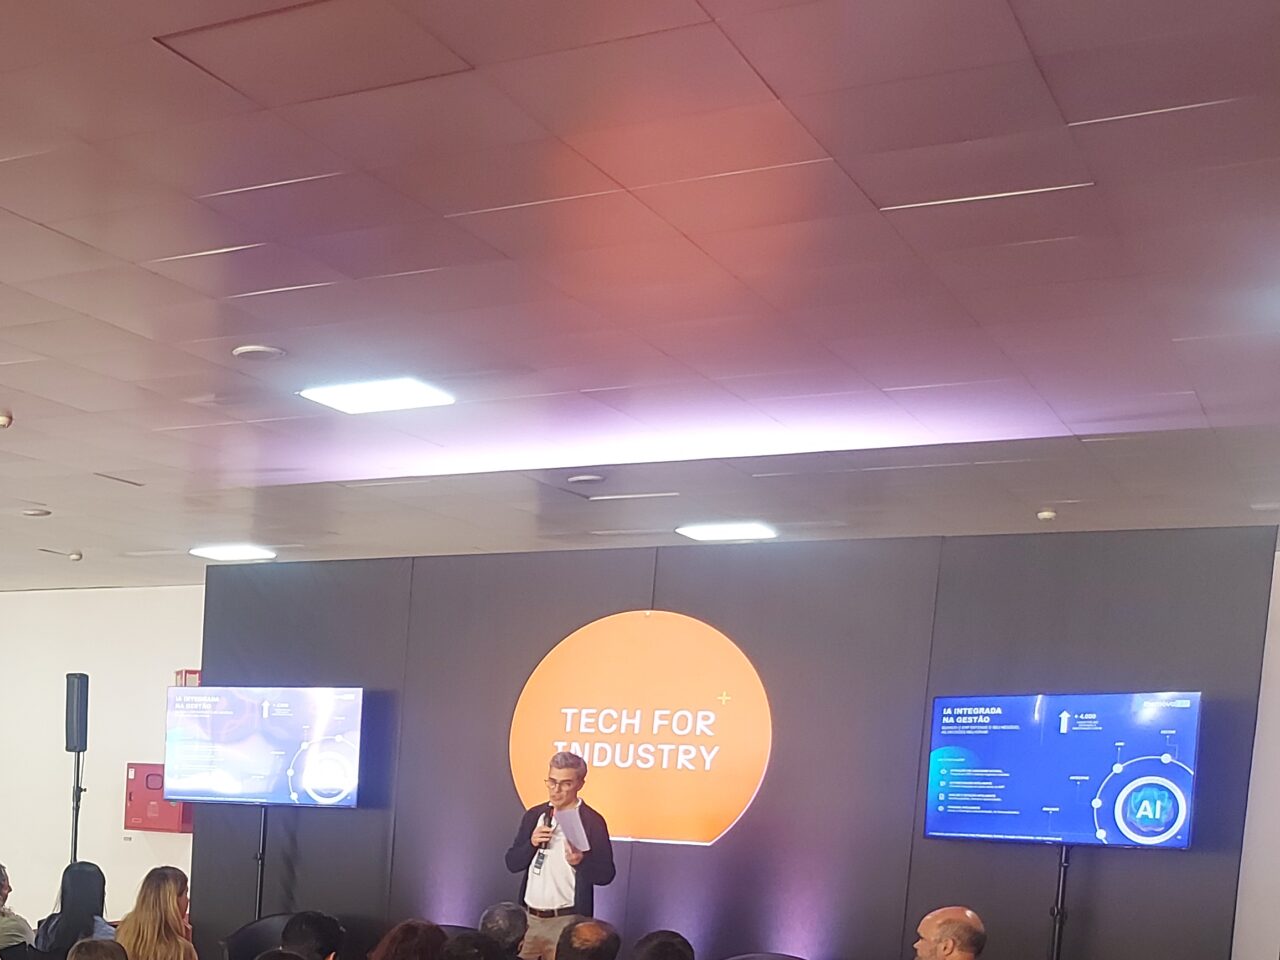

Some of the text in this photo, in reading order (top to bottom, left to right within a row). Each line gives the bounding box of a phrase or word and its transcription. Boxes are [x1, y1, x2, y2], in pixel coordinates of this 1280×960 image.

[943, 707, 1002, 715] IA INTEGRADA
[560, 708, 716, 736] TECH FOR
[942, 715, 991, 724] NA GESTÃO
[1135, 799, 1162, 819] AI
